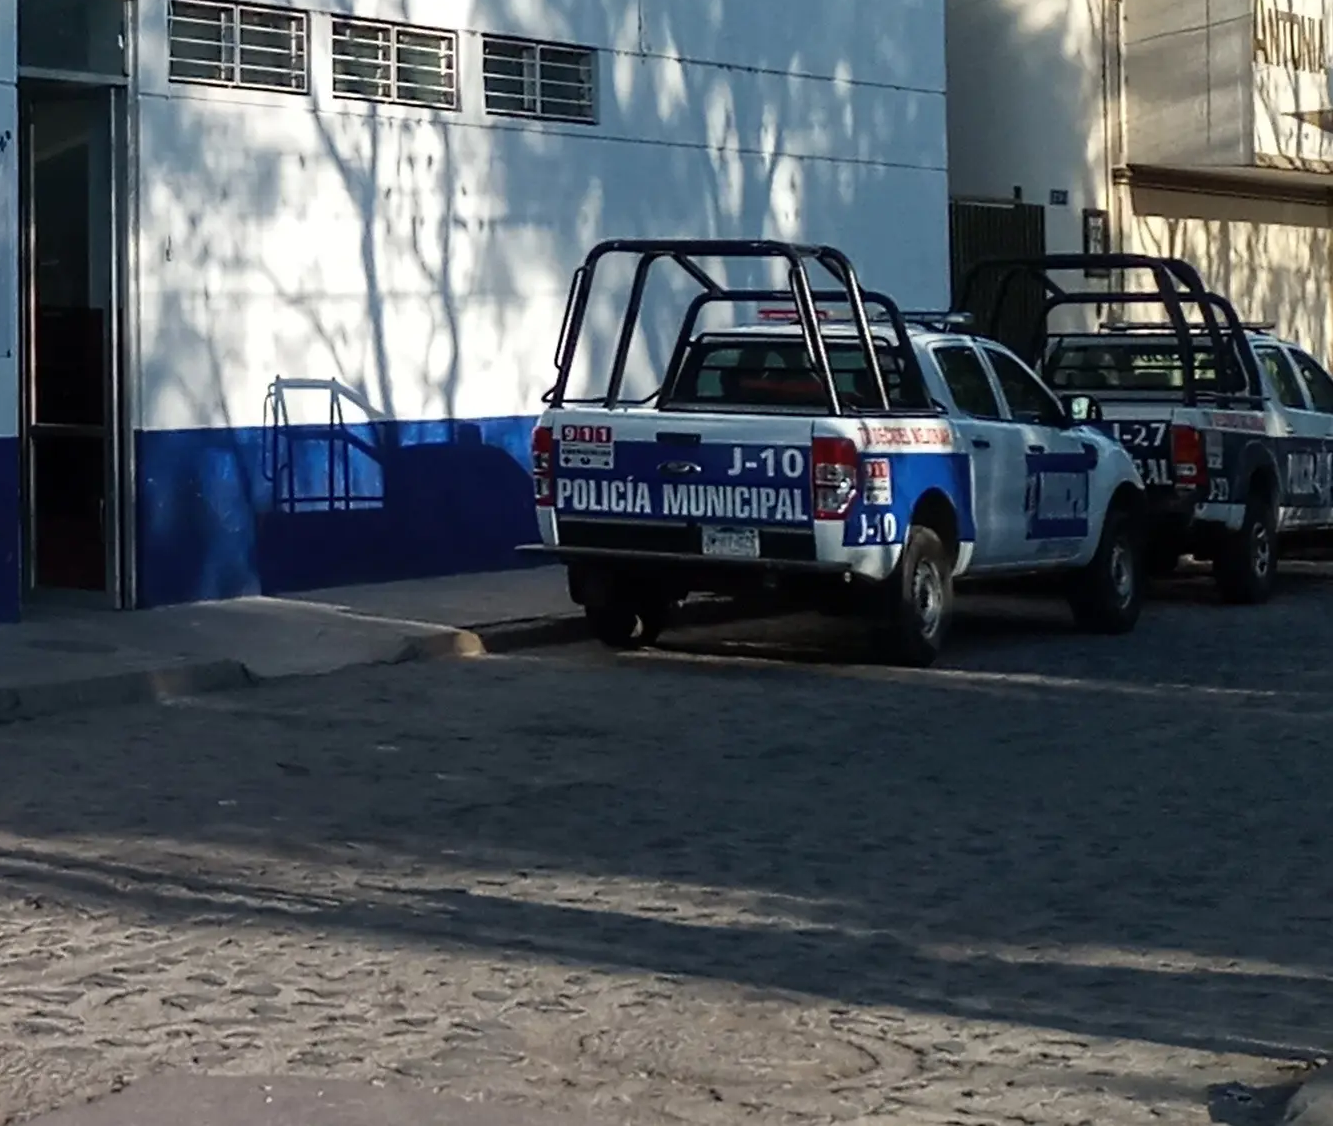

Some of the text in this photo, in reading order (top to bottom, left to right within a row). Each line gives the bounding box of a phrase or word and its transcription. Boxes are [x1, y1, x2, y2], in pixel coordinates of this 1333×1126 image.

[564, 426, 608, 442] 911
[727, 447, 805, 478] J-10
[556, 475, 809, 521] POLICÍA MUNICIPAL
[858, 512, 898, 544] J-10
